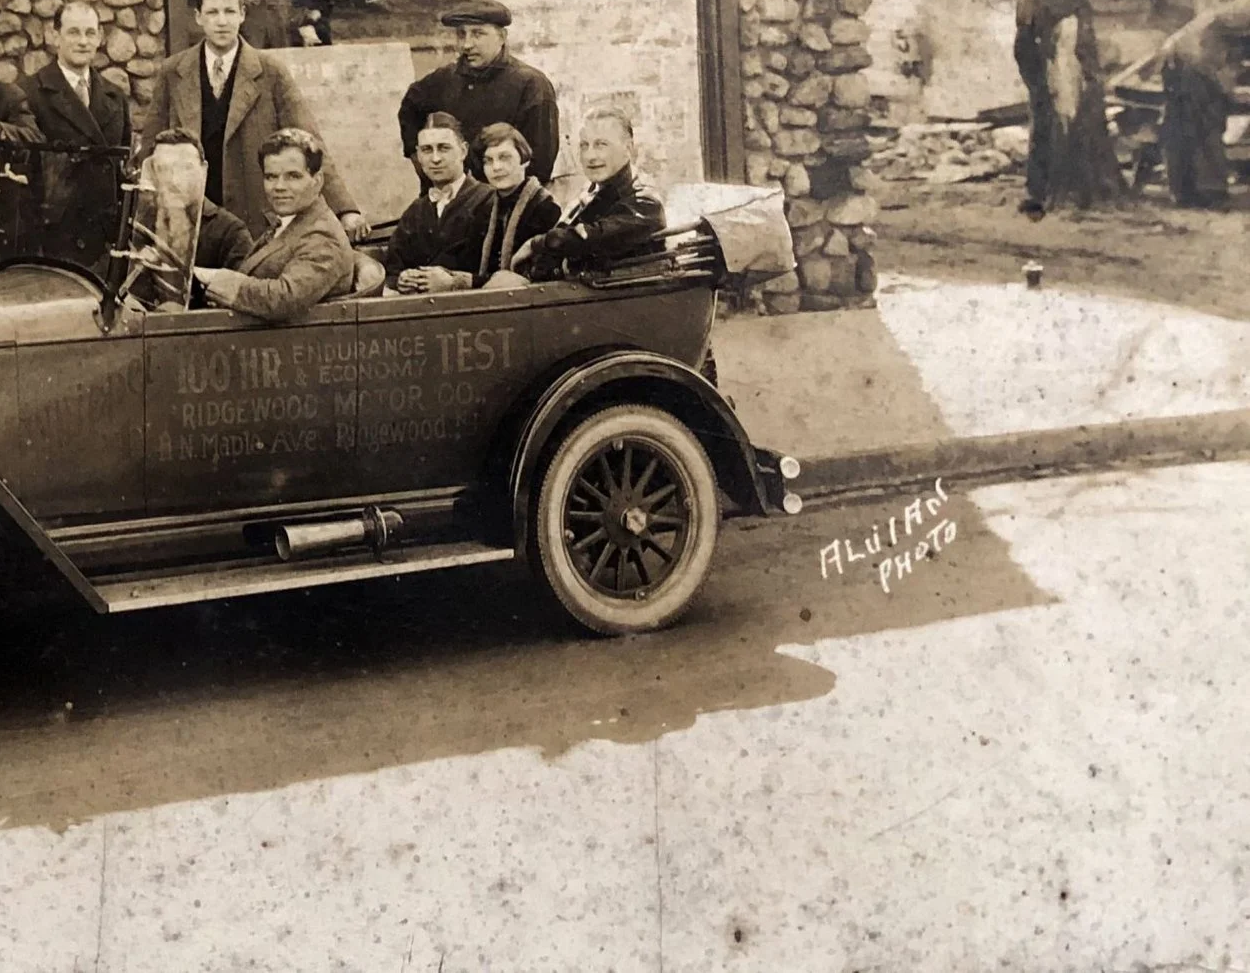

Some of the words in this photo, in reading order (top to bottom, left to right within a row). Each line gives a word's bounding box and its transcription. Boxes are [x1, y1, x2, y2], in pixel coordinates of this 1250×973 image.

[292, 334, 426, 365] ENDURANCE
[435, 326, 515, 375] TEST
[318, 357, 427, 386] ECONOMY
[182, 393, 319, 431] RIDGEWOOD
[333, 384, 425, 417] MOTOR
